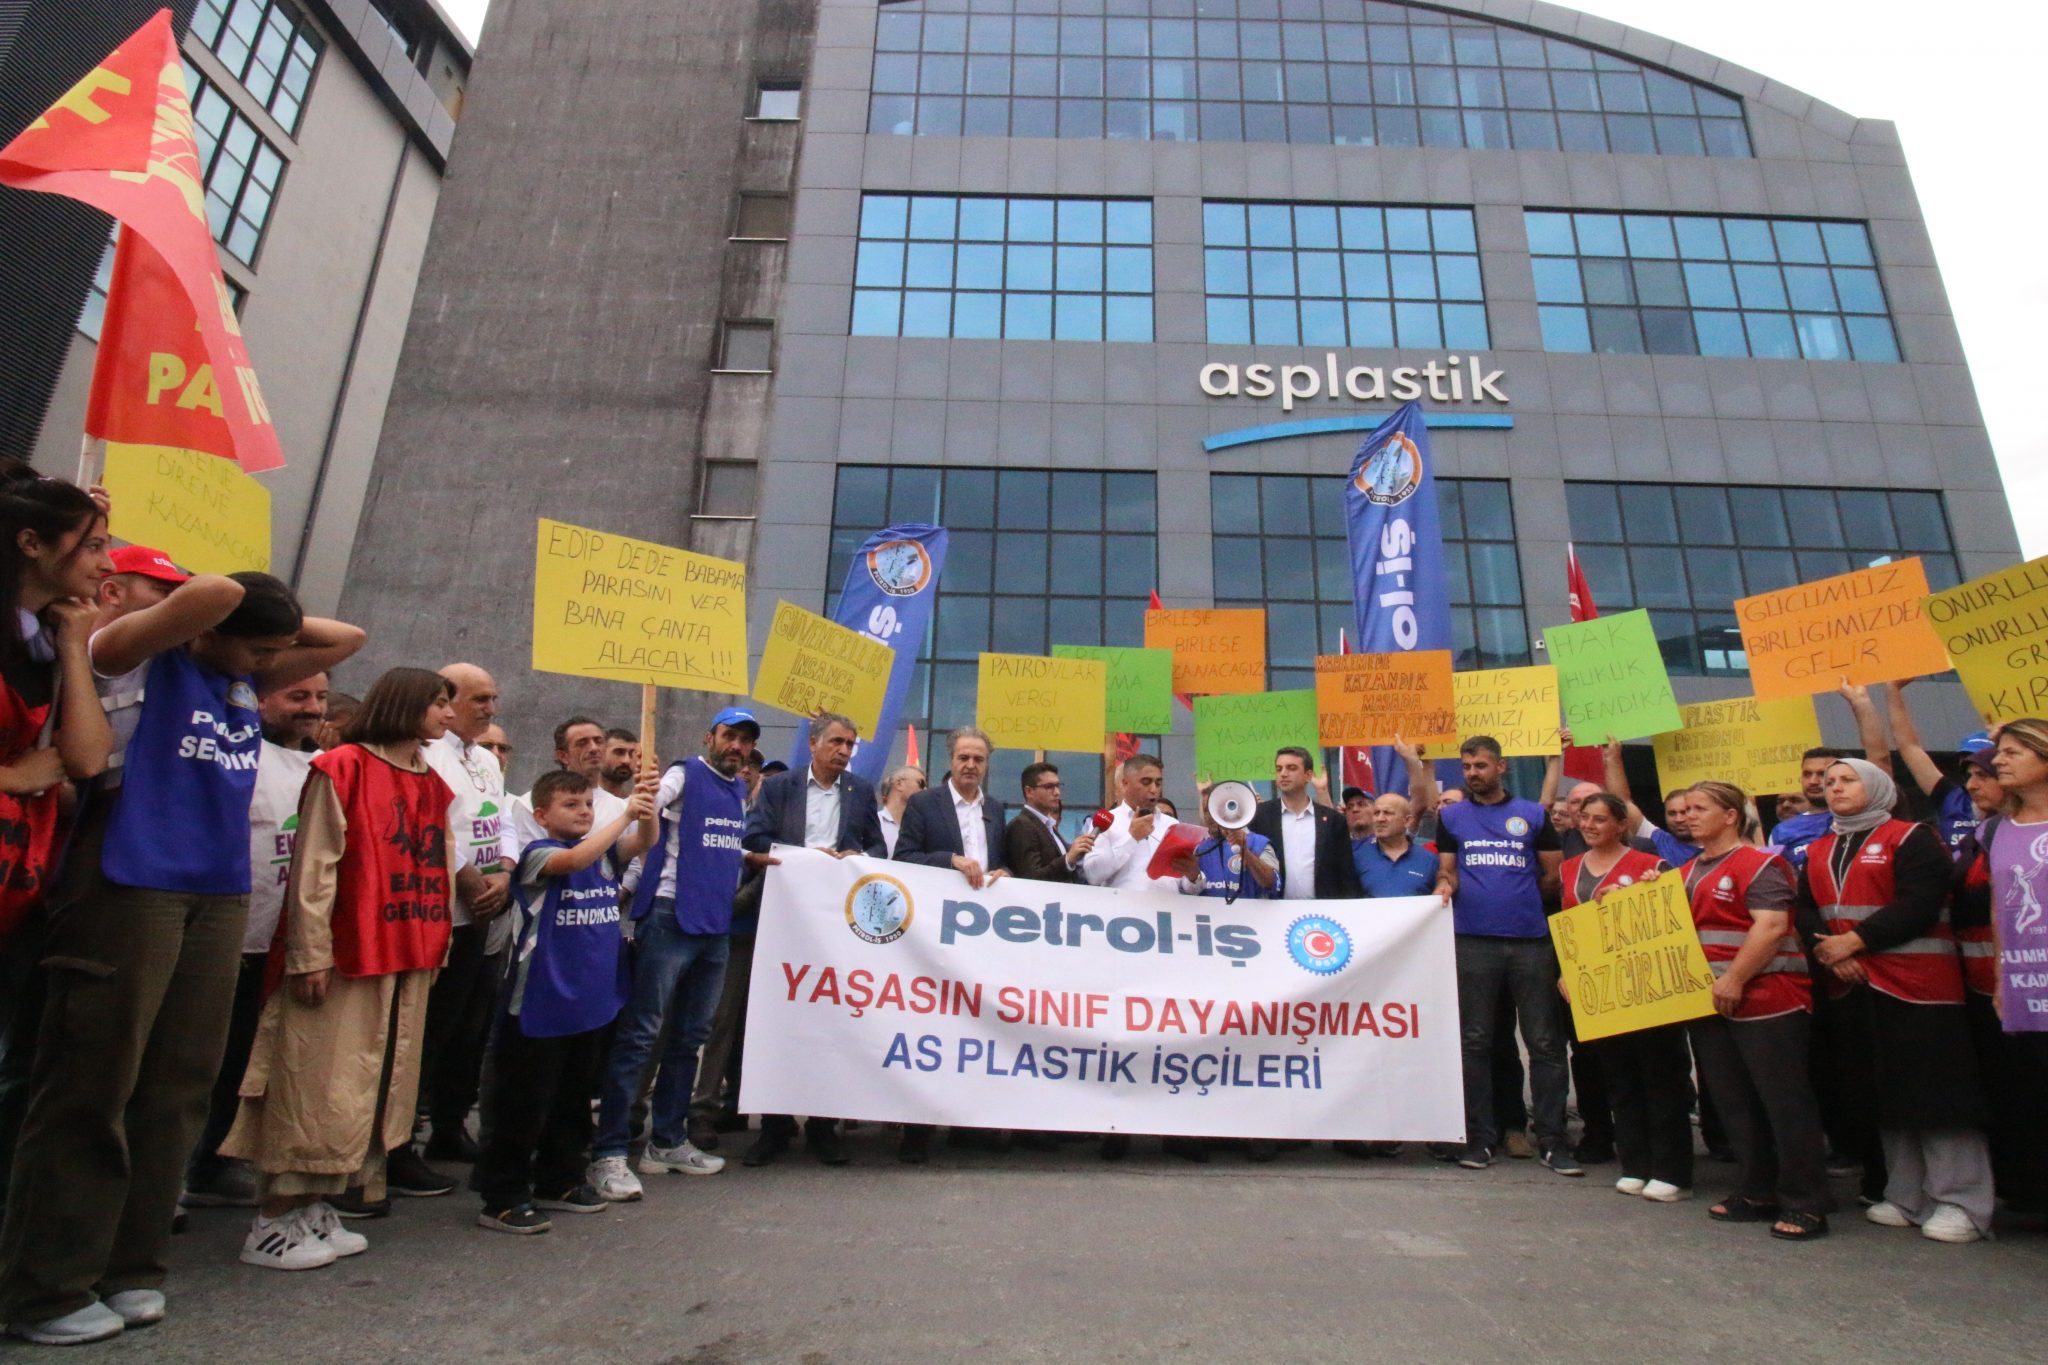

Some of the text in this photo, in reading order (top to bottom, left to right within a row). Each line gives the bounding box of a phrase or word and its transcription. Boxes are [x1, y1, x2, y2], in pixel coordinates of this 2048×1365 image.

[1199, 352, 1510, 412] asplastik
[548, 525, 745, 593] EDİP DEDE BABAMA
[582, 569, 732, 616] PARASINI VER
[564, 600, 711, 646] BANA ÇANTA
[1553, 621, 1625, 658] HAK
[598, 640, 704, 676] ALACAK
[991, 656, 1098, 683] PATRONLAR
[1564, 657, 1646, 690] HUKUK
[1343, 671, 1429, 693] KAZANDIK
[1361, 692, 1422, 713] MASADA
[1686, 699, 1761, 729] PLASTİK
[1465, 851, 1526, 868] SENDİKASI
[940, 899, 1262, 968] petrol-iş
[1596, 884, 1683, 954] EKMEK
[782, 962, 1419, 1045] YAŞASIN SINIF DAYANIŞMASI
[882, 1032, 1322, 1096] AS PLASTİK İŞÇİLERİ
